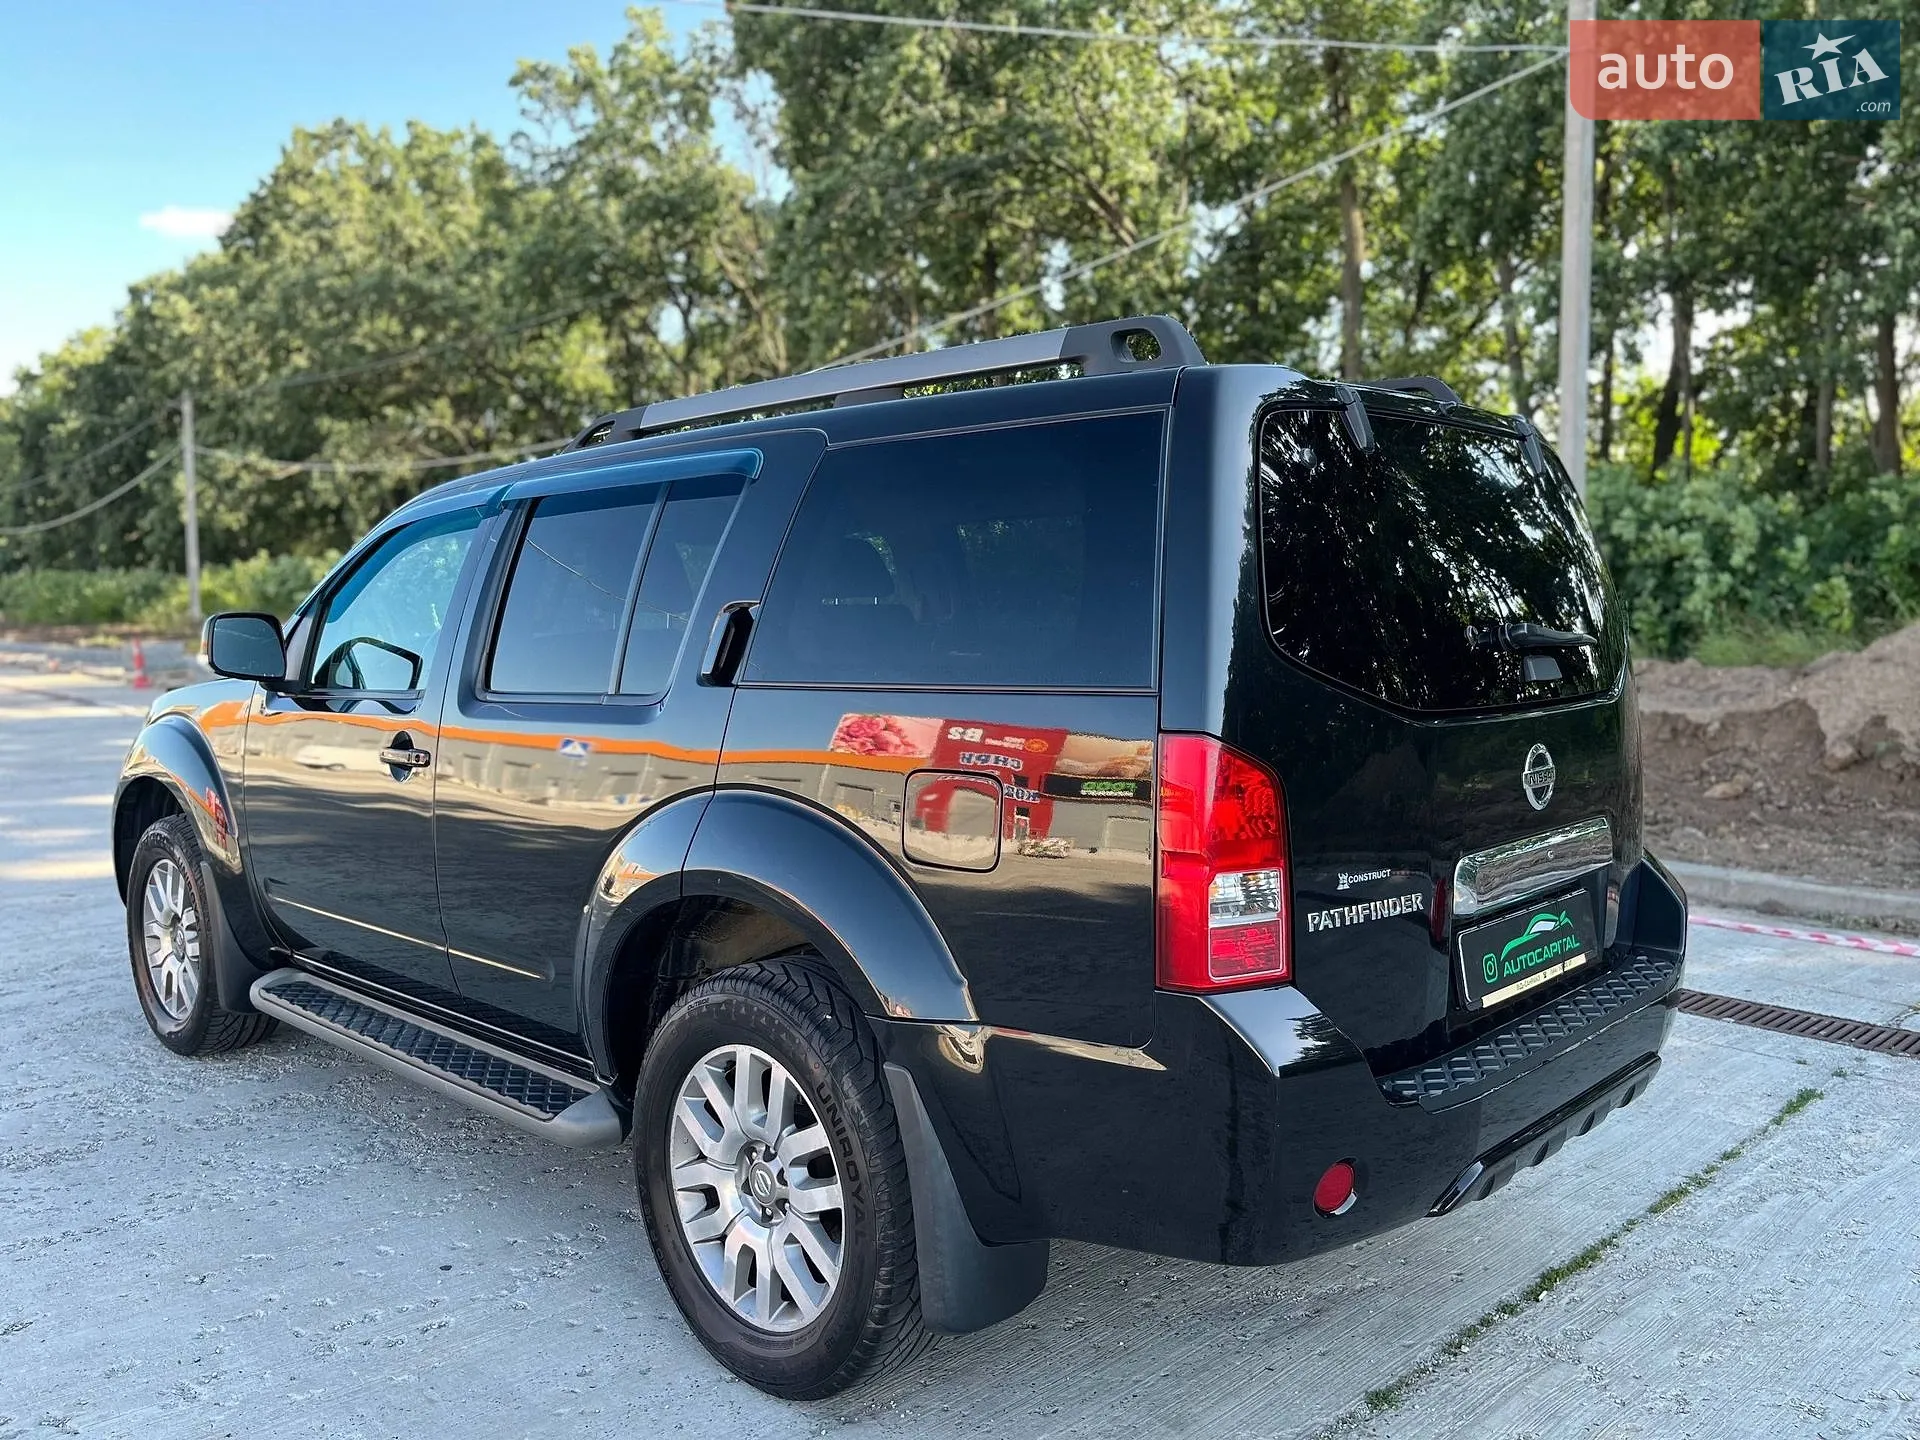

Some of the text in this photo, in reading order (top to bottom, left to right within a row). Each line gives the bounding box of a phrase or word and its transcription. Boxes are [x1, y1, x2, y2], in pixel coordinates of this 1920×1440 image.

[1348, 869, 1391, 884] CONSTRUCT
[1307, 893, 1424, 932] PATHFINDER
[1503, 934, 1580, 978] AUTOCAPITAL
